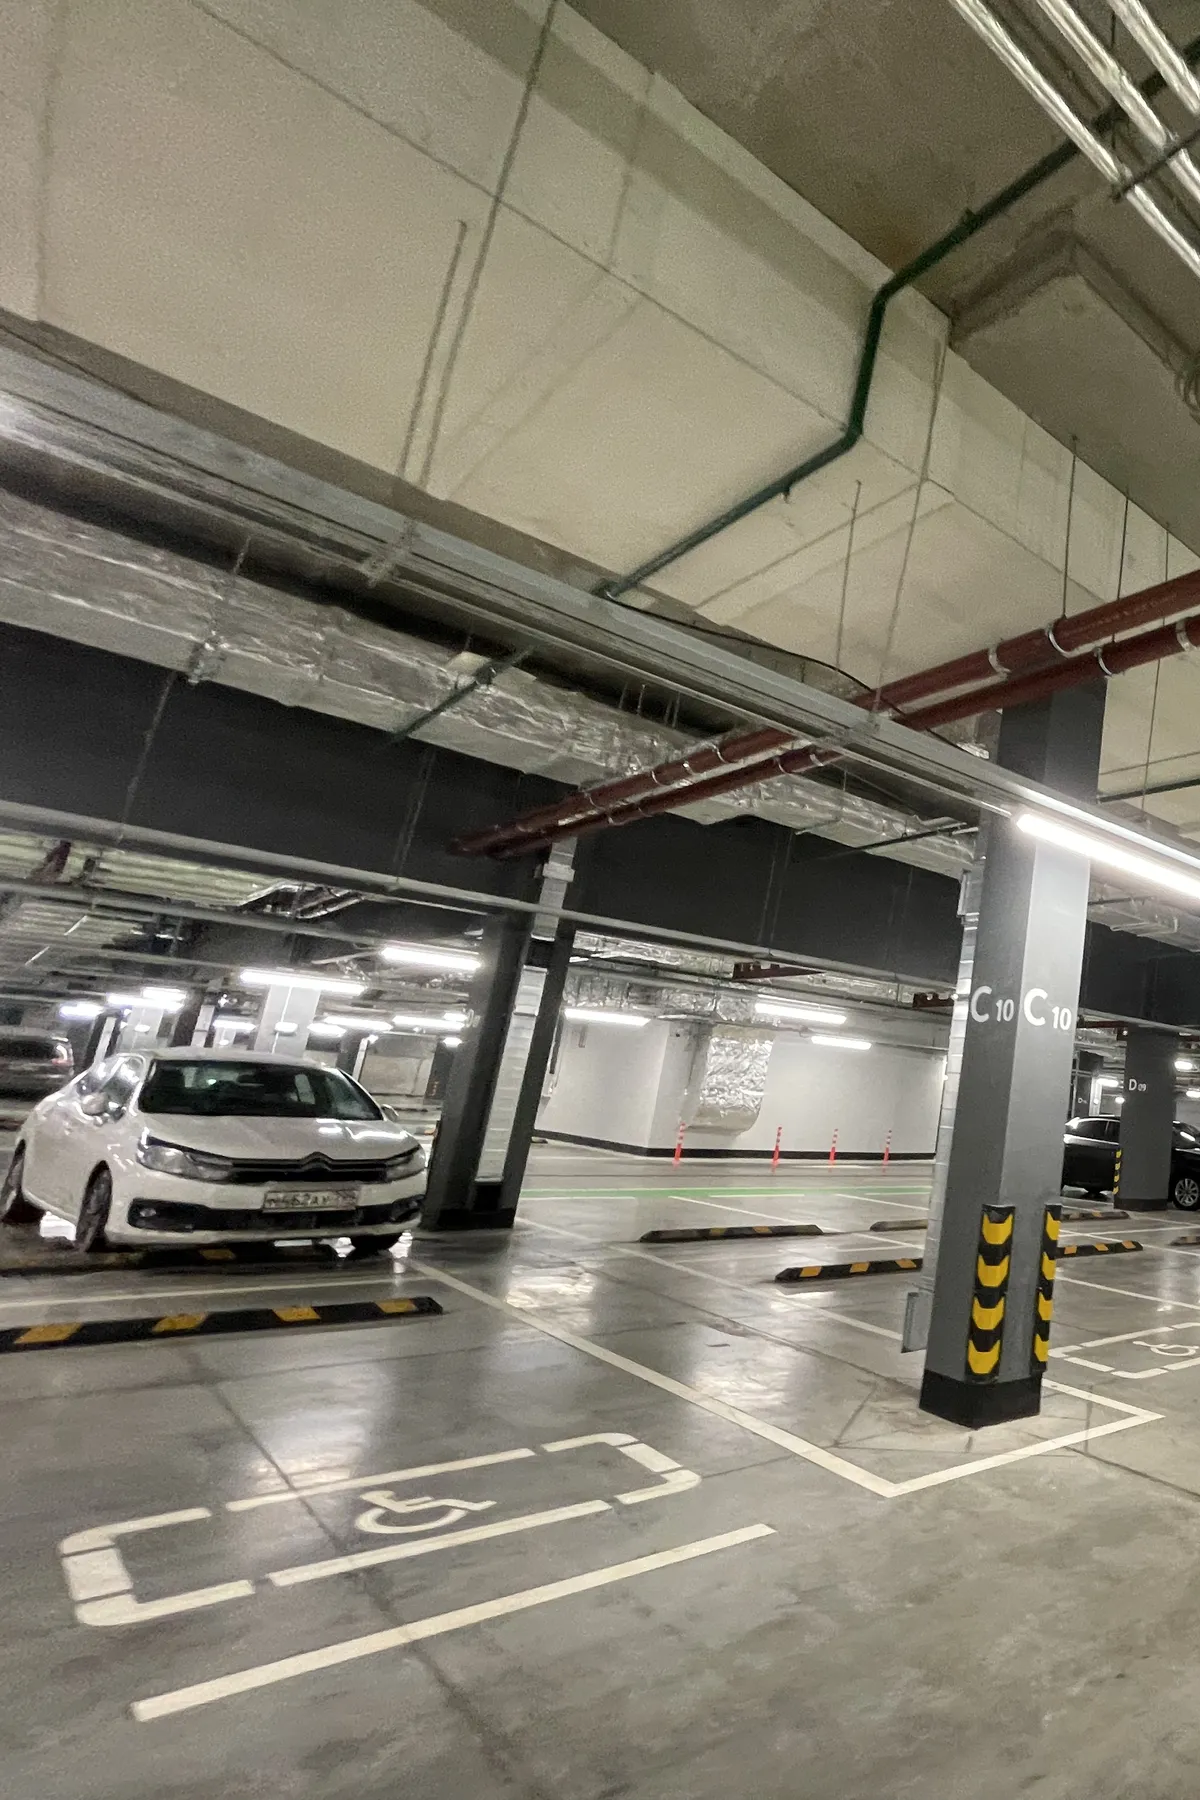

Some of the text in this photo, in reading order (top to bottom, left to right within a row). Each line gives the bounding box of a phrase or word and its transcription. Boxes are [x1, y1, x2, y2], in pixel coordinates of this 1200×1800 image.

[970, 985, 1015, 1023] C 10
[1023, 987, 1072, 1031] C 10
